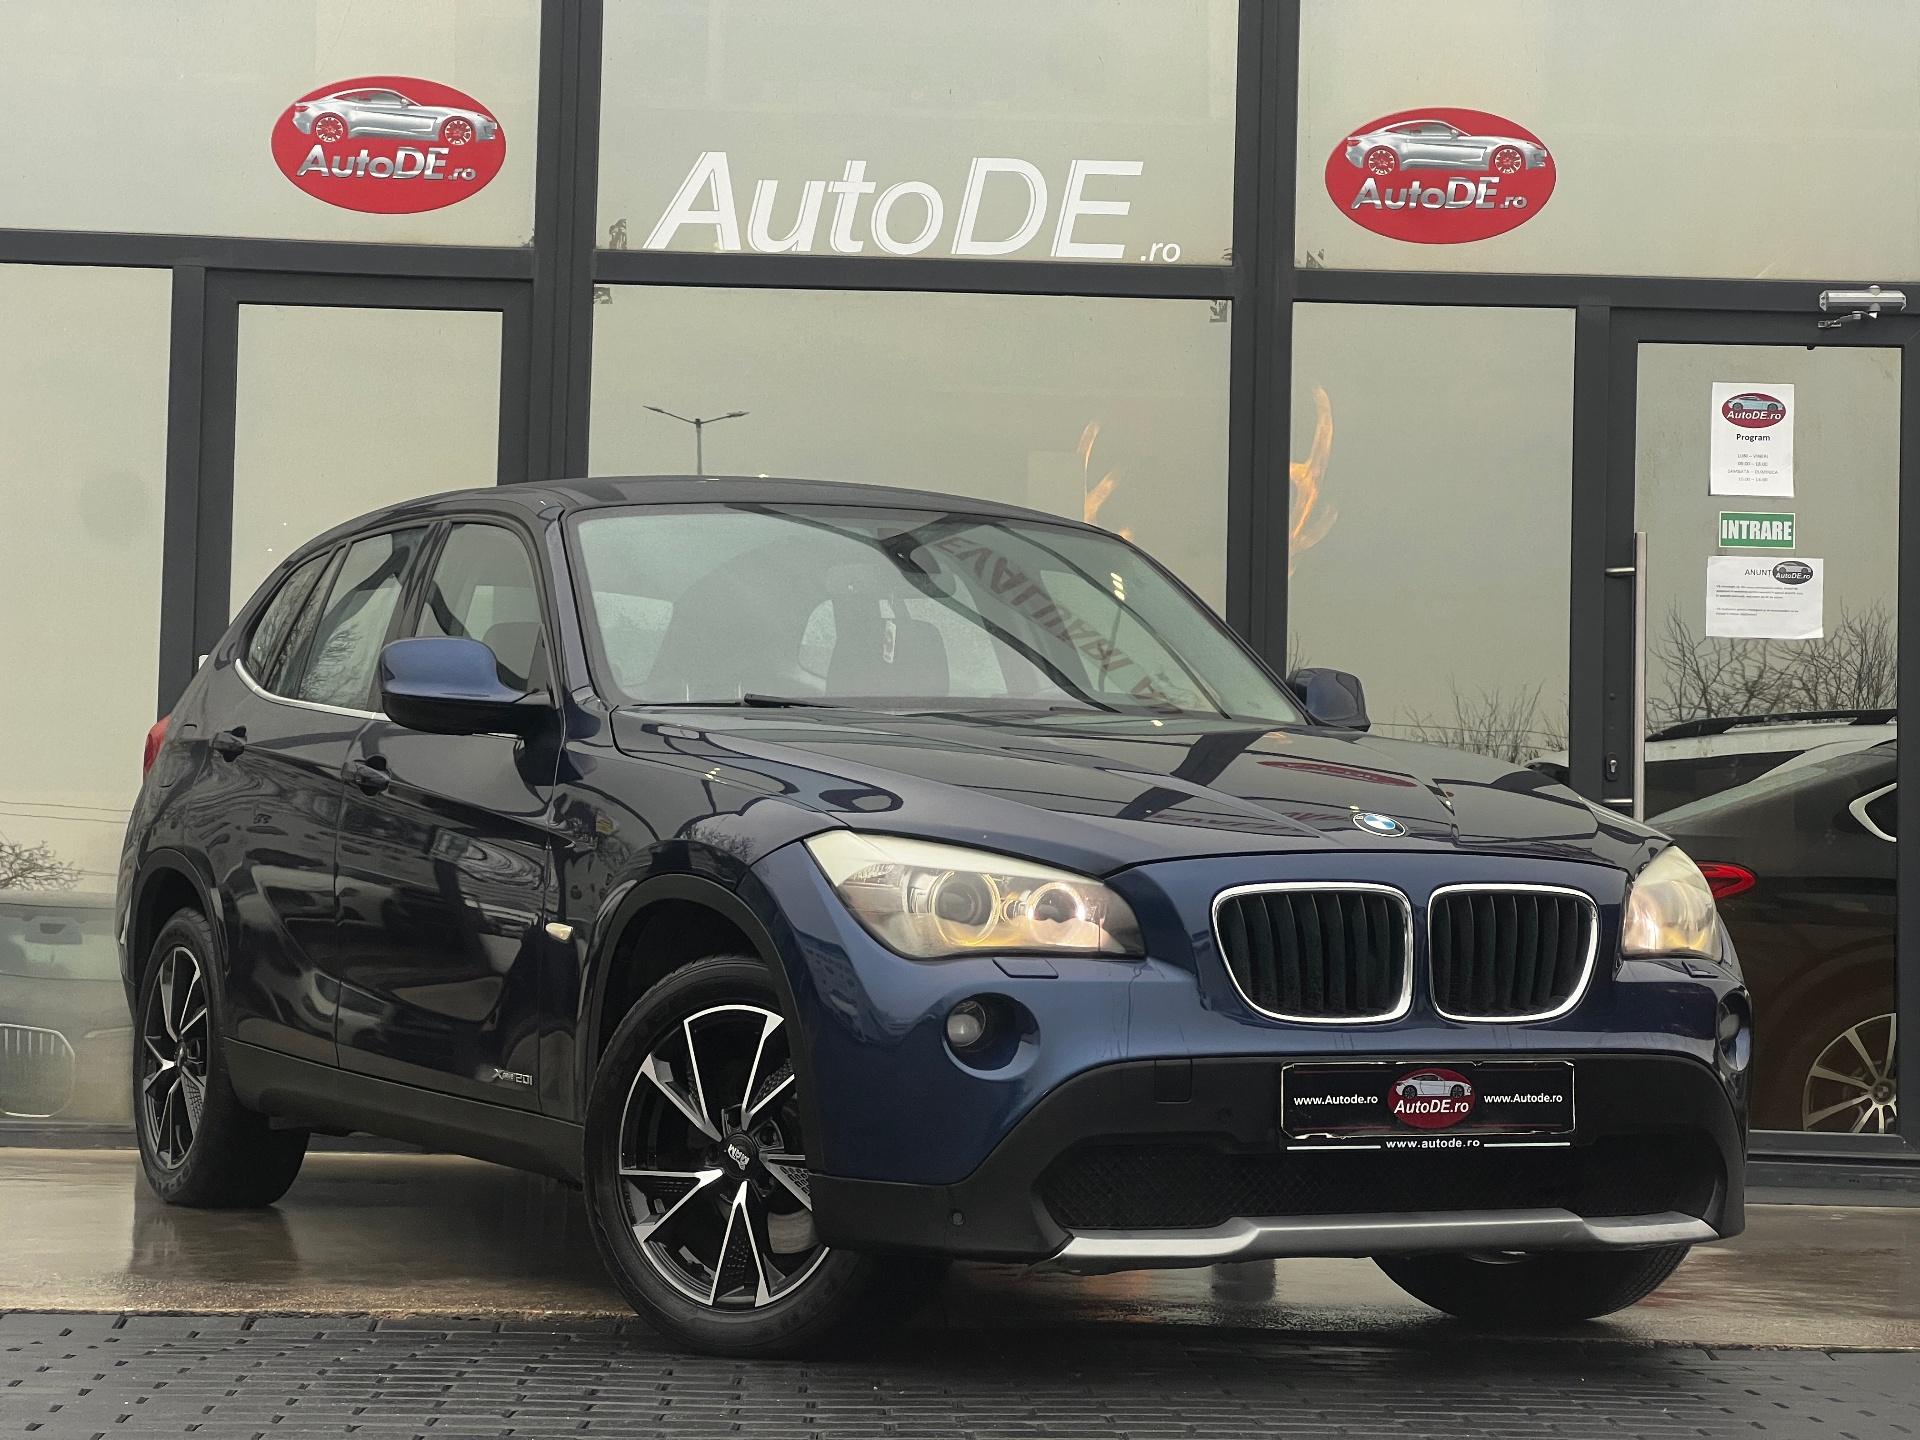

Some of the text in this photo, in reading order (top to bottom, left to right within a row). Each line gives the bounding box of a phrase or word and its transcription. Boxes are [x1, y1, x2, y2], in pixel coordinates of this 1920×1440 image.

[1727, 410, 1782, 420] AutoDE.ro
[1736, 433, 1771, 442] Program
[1721, 519, 1792, 540] INTRARE
[1293, 1094, 1378, 1106] www.Autode.ro
[1483, 1093, 1563, 1104] www.Autode.ro
[1393, 1099, 1470, 1114] AutoDE.ro
[1385, 1138, 1481, 1149] www.autode.ro
